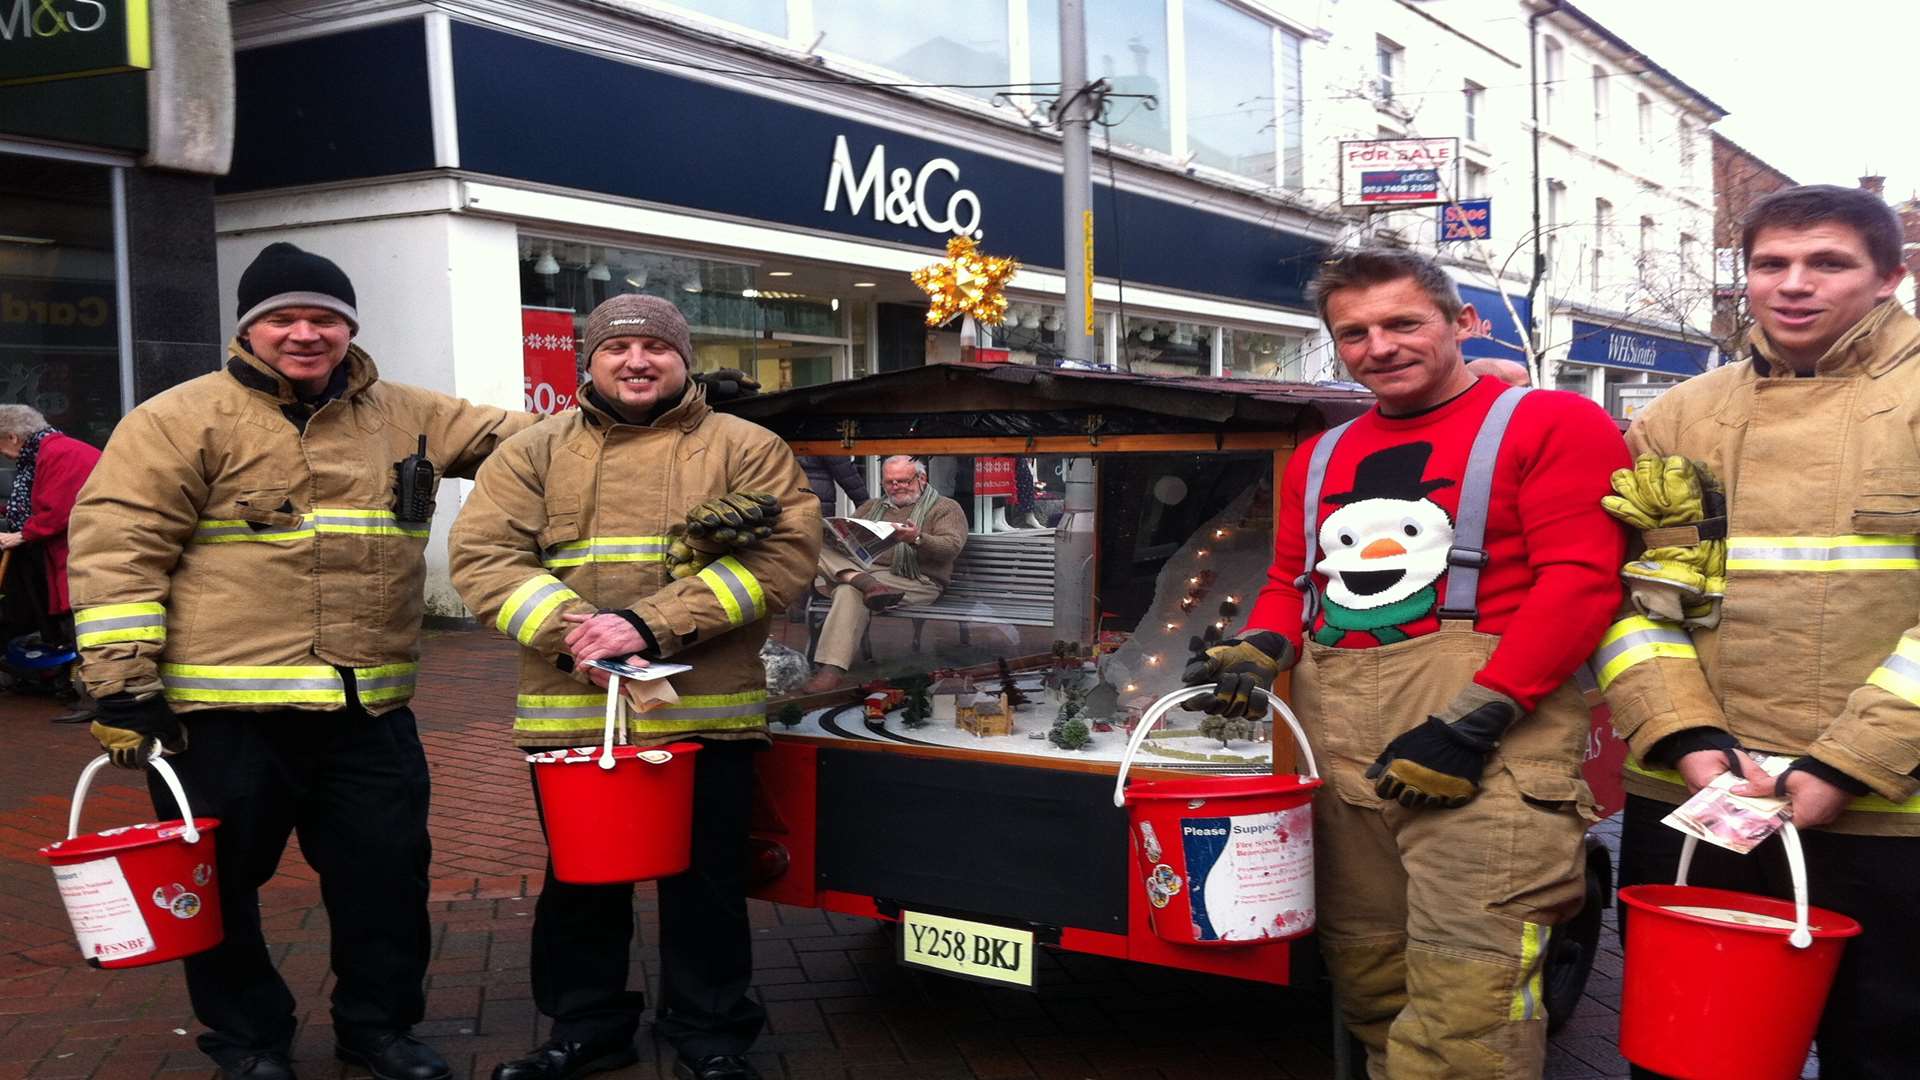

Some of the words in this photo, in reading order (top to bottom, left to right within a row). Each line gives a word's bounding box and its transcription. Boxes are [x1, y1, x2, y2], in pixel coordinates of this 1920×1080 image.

[1348, 149, 1388, 160] FOR
[1398, 148, 1449, 160] SALE
[824, 134, 984, 240] M&Co.
[1445, 207, 1487, 221] Shoe
[1445, 223, 1487, 238] Zone
[1608, 333, 1657, 366] WHSmith
[1183, 826, 1227, 836] Please
[910, 923, 966, 962] Y258
[972, 935, 1023, 971] BKJ
